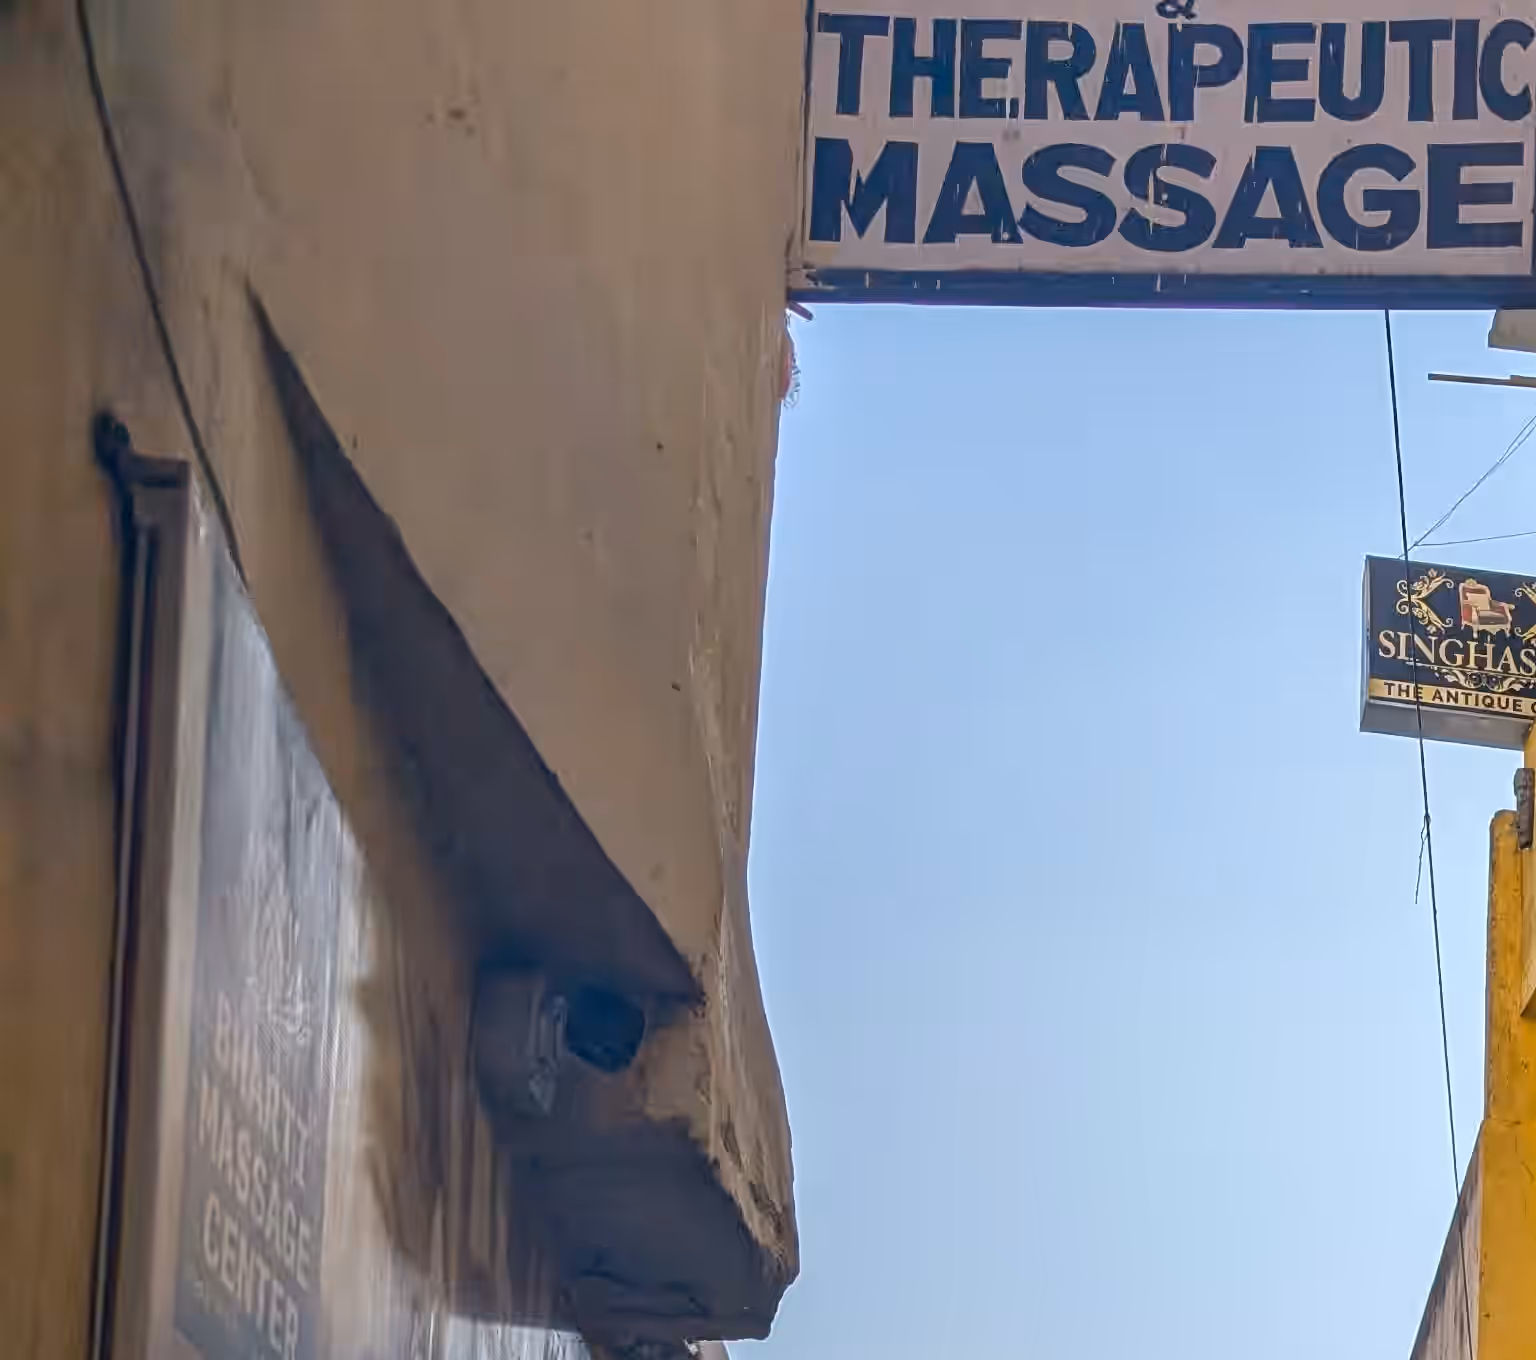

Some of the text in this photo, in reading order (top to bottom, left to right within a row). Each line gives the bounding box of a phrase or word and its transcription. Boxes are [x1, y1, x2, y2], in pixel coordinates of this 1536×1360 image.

[817, 13, 1536, 123] THERAPEUTIC
[808, 138, 1526, 252] MASSAGE
[1384, 681, 1424, 700] THE
[1432, 687, 1523, 713] ANTIQUE
[198, 1068, 312, 1293] MASSAGE
